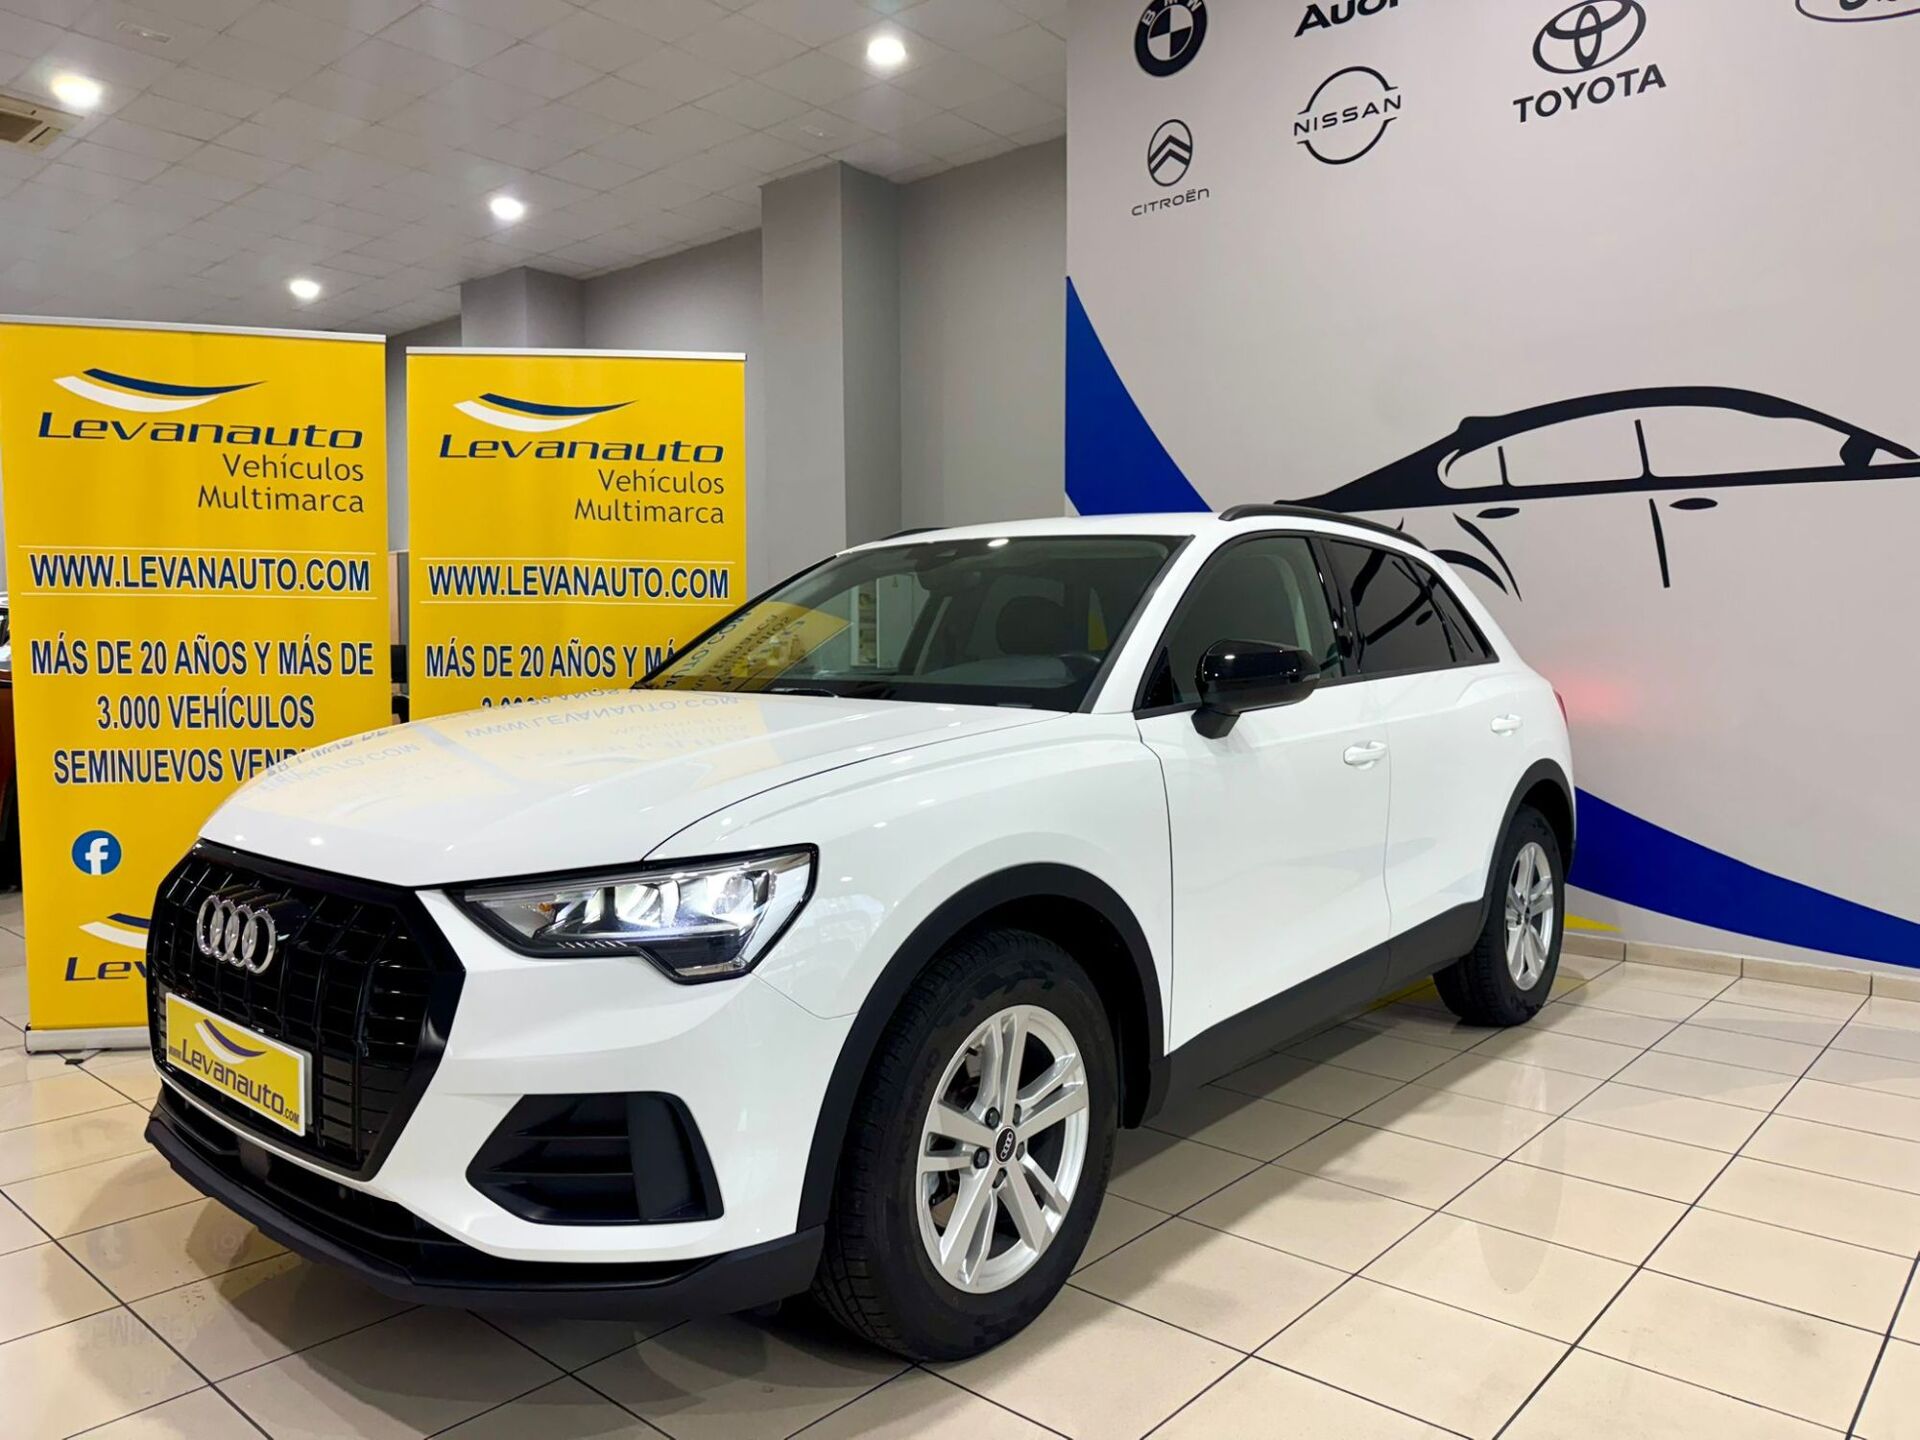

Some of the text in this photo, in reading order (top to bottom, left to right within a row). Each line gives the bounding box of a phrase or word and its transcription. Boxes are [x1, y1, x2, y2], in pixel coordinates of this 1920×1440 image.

[1512, 63, 1667, 123] TOYOTA
[1294, 94, 1401, 136] NISSAN
[38, 411, 363, 449] Levanauto
[222, 453, 364, 482] Vehículos
[439, 434, 724, 464] Levanauto
[197, 485, 364, 513] Multimarca
[598, 468, 724, 494] Vehículos
[574, 498, 725, 524] Multimarca
[29, 553, 370, 592] WWW.LEVANAUTO.COM
[428, 565, 728, 599] WWW.LEVANAUTO.COM
[31, 632, 374, 676] MÁS DE 20 AÑOS Y MÁS DE
[426, 638, 476, 677] MÁS
[483, 645, 513, 677] DE
[520, 645, 544, 678] 20
[550, 638, 616, 677] AÑOS
[622, 646, 638, 677] Y
[97, 687, 315, 730] 3.000 VEHÍCULOS
[54, 748, 224, 784] SEMINUEVOS
